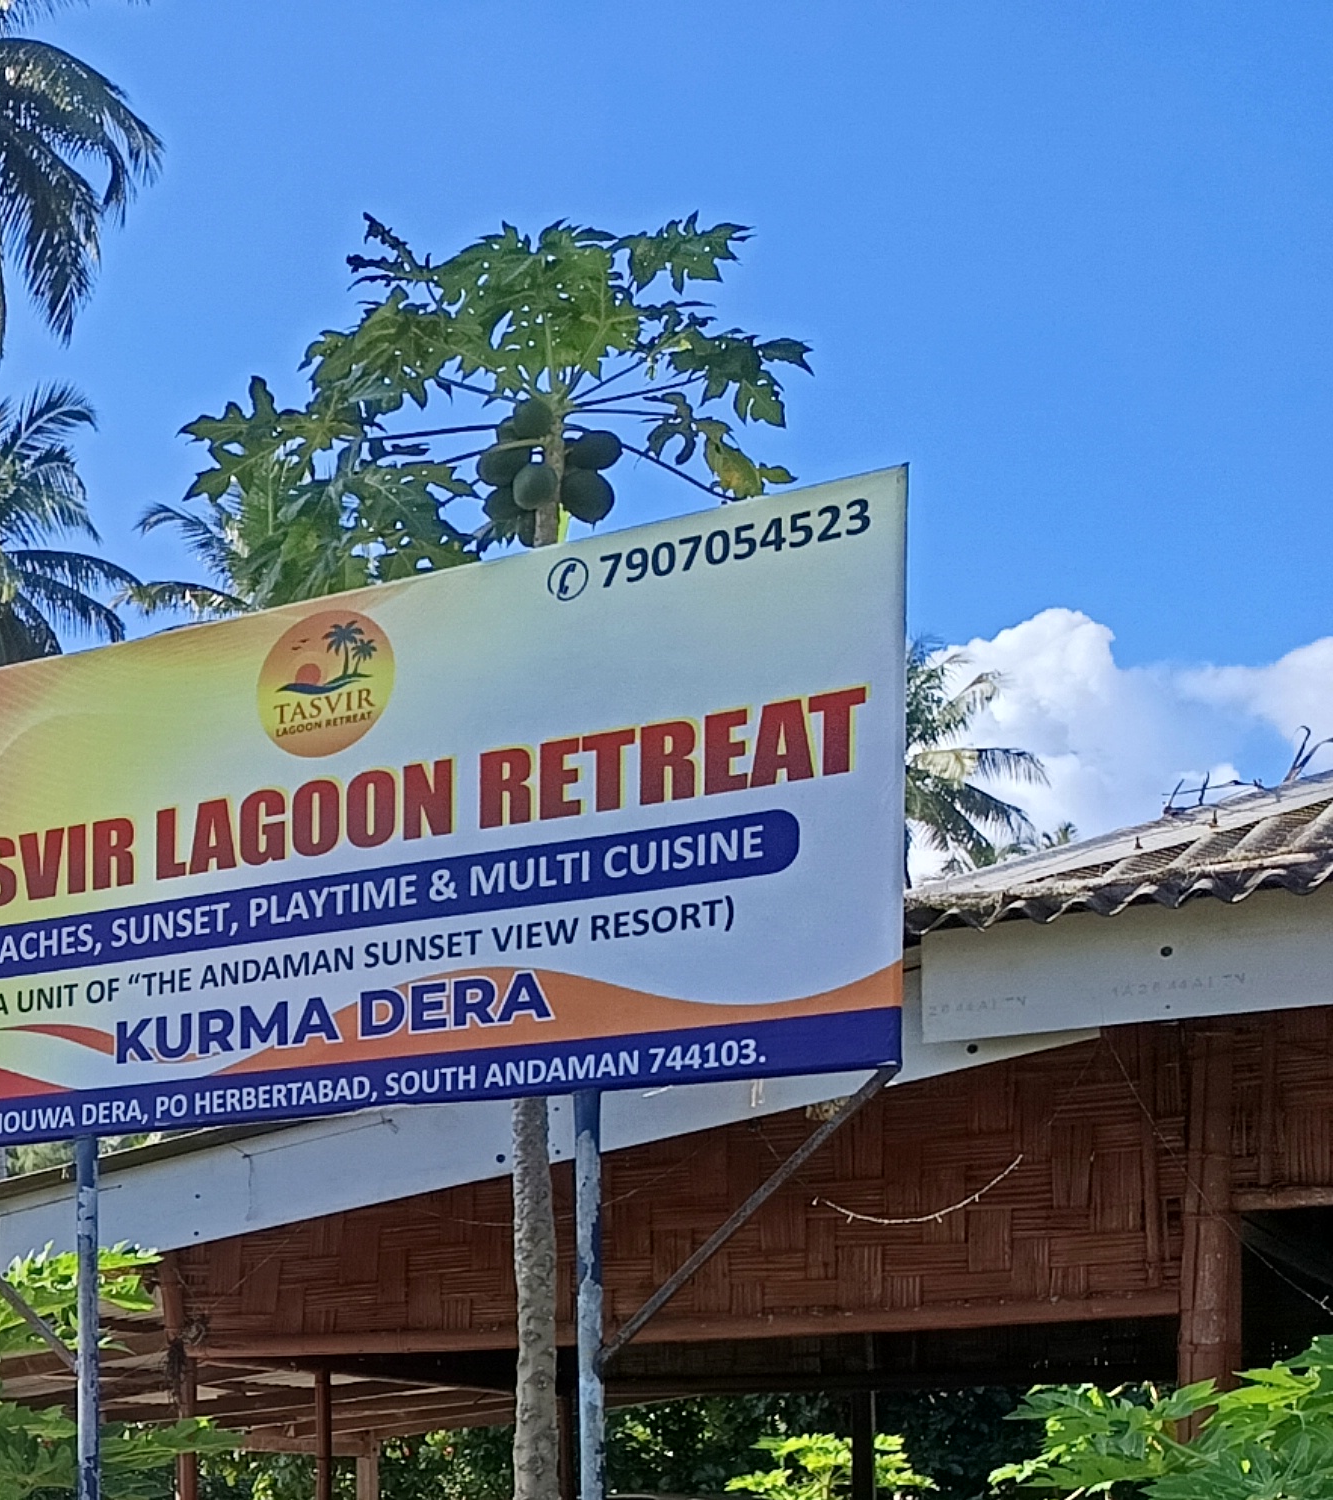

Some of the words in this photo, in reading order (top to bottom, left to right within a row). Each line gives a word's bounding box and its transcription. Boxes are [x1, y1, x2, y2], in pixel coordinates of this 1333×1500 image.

[600, 498, 871, 588] 7907054523
[273, 688, 375, 725] TASVIR
[276, 721, 322, 737] LAGOON
[325, 711, 373, 728] RETREAT
[155, 758, 453, 880] LAGOON
[479, 686, 867, 830] RETREAT
[111, 902, 239, 946] SUNSET,
[249, 874, 418, 928] PLAYTIME
[428, 870, 458, 901] &
[470, 851, 590, 897] MULTI
[603, 824, 764, 879] CUISINE
[17, 983, 79, 1013] UNIT
[85, 978, 120, 1007] OF
[200, 946, 354, 991] ANDAMAN
[363, 930, 482, 968] SUNSET
[492, 917, 578, 953] VIEW
[590, 895, 735, 942] RESORT)
[115, 995, 341, 1064] KURMA
[358, 972, 551, 1037] DERA
[81, 1099, 149, 1127] DERA,
[155, 1093, 188, 1121] PO
[193, 1075, 378, 1114] HERBERTABAD,
[385, 1067, 476, 1097] SOUTH
[484, 1050, 639, 1088] ANDAMAN
[648, 1039, 766, 1072] 744103.
